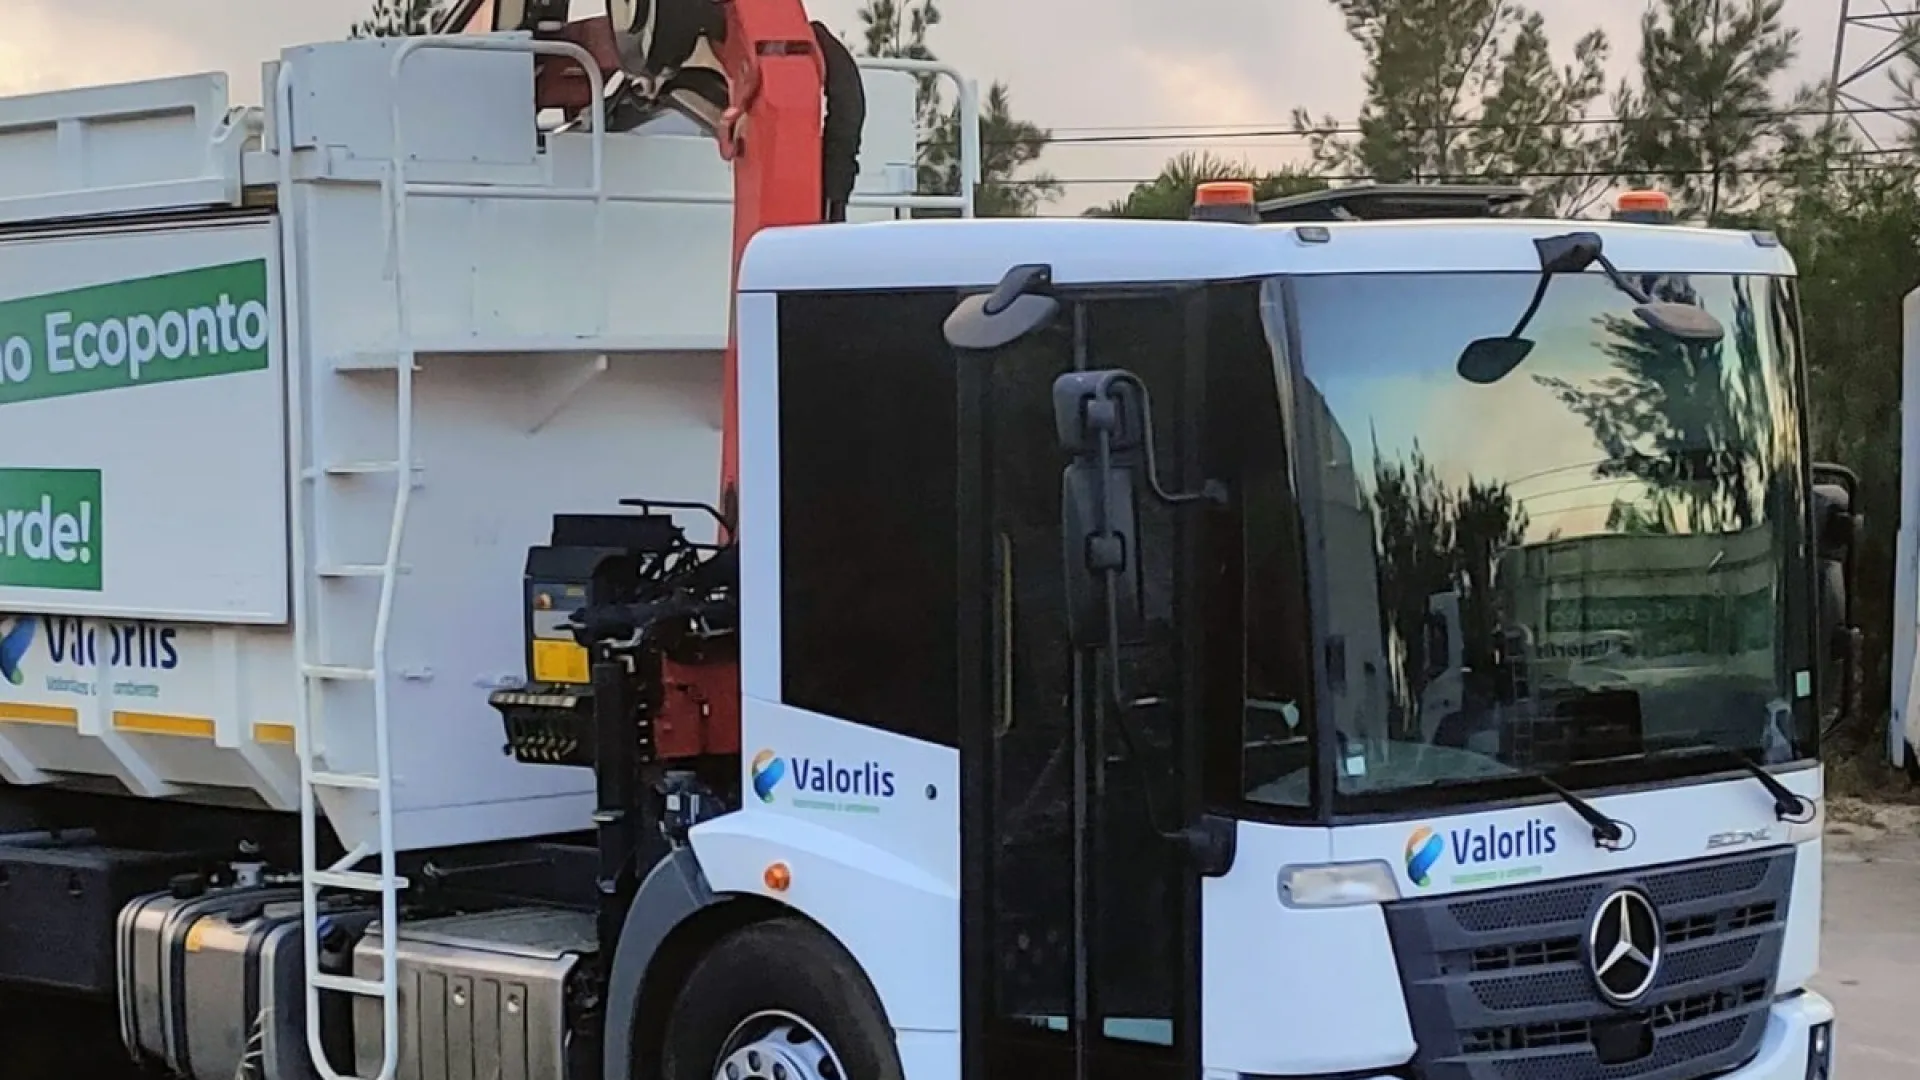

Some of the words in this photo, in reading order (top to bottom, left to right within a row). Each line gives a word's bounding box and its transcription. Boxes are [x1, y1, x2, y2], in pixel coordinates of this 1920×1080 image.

[0, 336, 32, 384] o
[45, 293, 269, 380] Ecoponto
[0, 494, 91, 564] rde!
[792, 757, 895, 797] Valorlis
[1451, 818, 1556, 865] Valorlis
